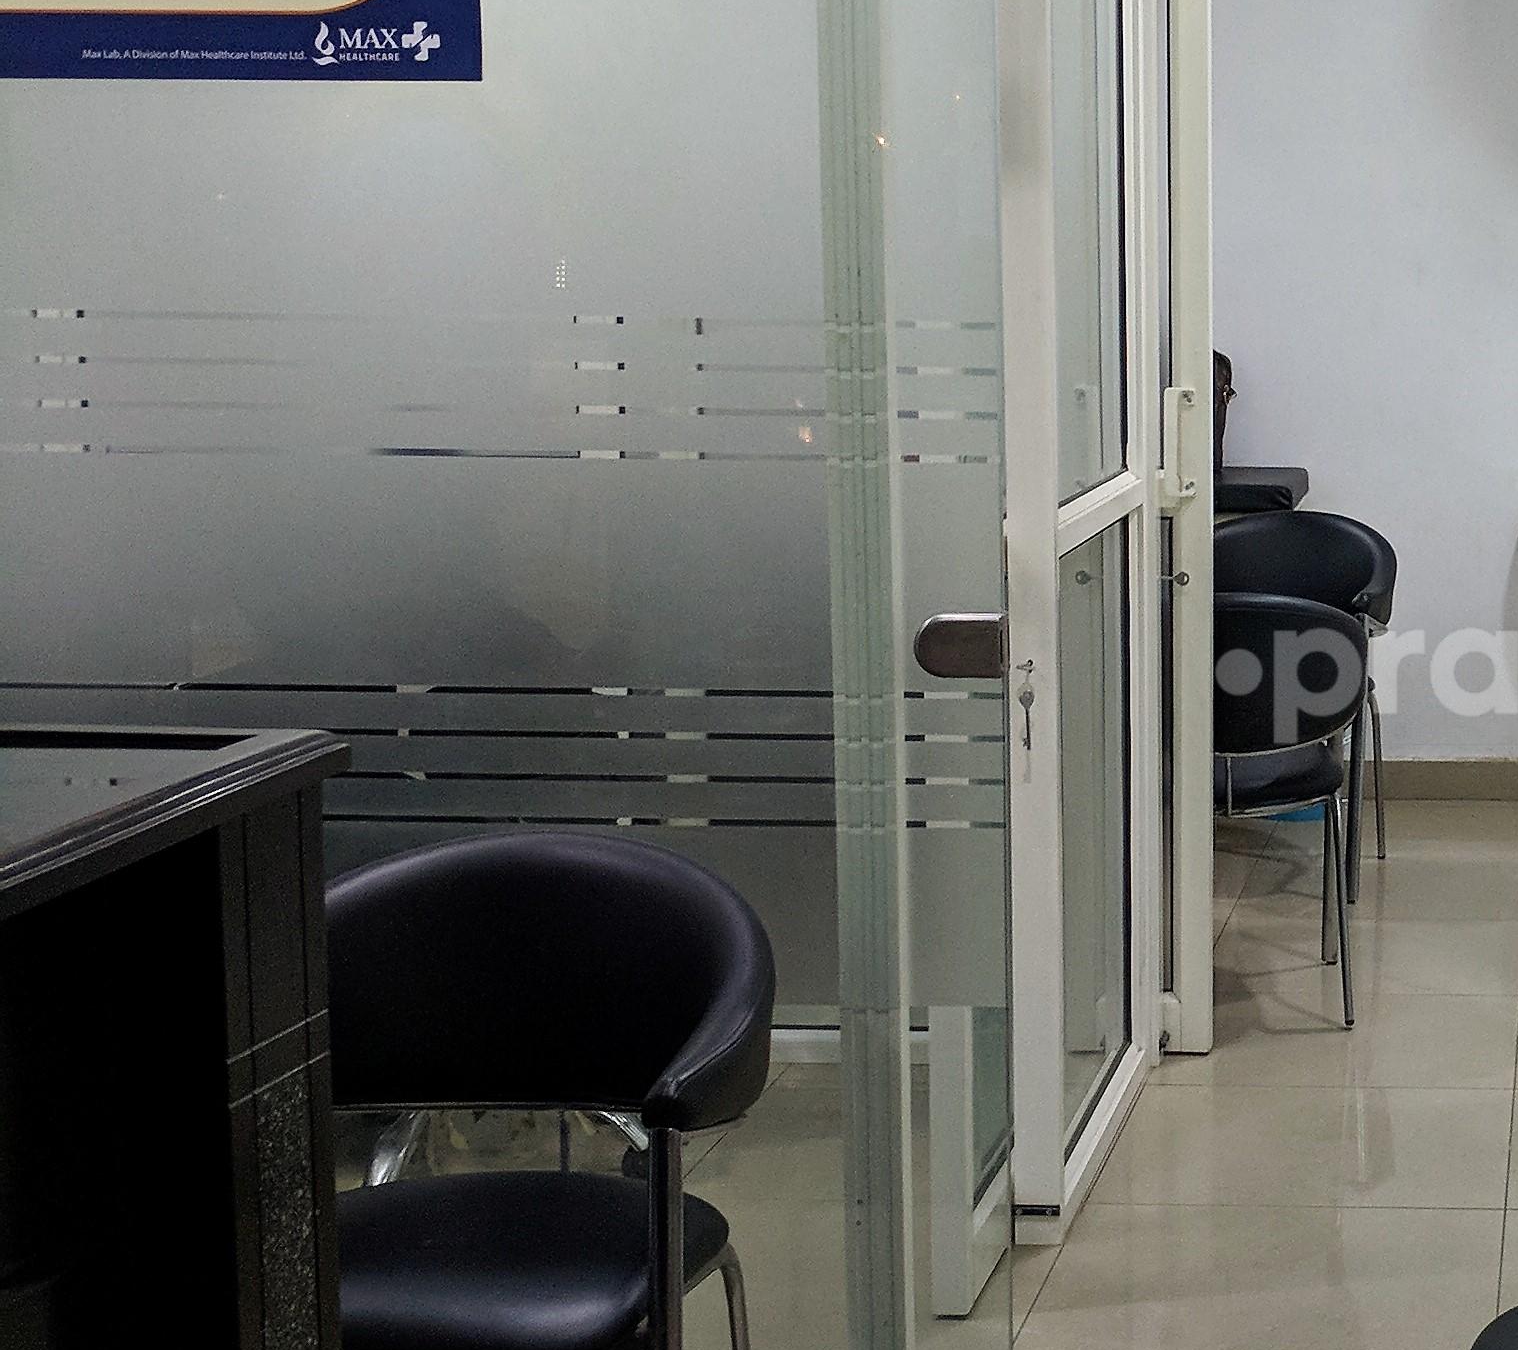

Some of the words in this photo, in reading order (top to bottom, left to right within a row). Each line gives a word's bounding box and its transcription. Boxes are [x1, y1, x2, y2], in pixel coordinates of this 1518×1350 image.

[339, 28, 399, 49] MAX
[81, 49, 101, 60] Max
[124, 49, 131, 60] A
[132, 49, 168, 60] Division
[169, 49, 179, 60] of
[180, 49, 200, 60] Max
[201, 49, 249, 60] Healthcare
[250, 49, 288, 60] Institute
[289, 49, 308, 60] Ltd.
[339, 52, 400, 62] HEALTHCARE
